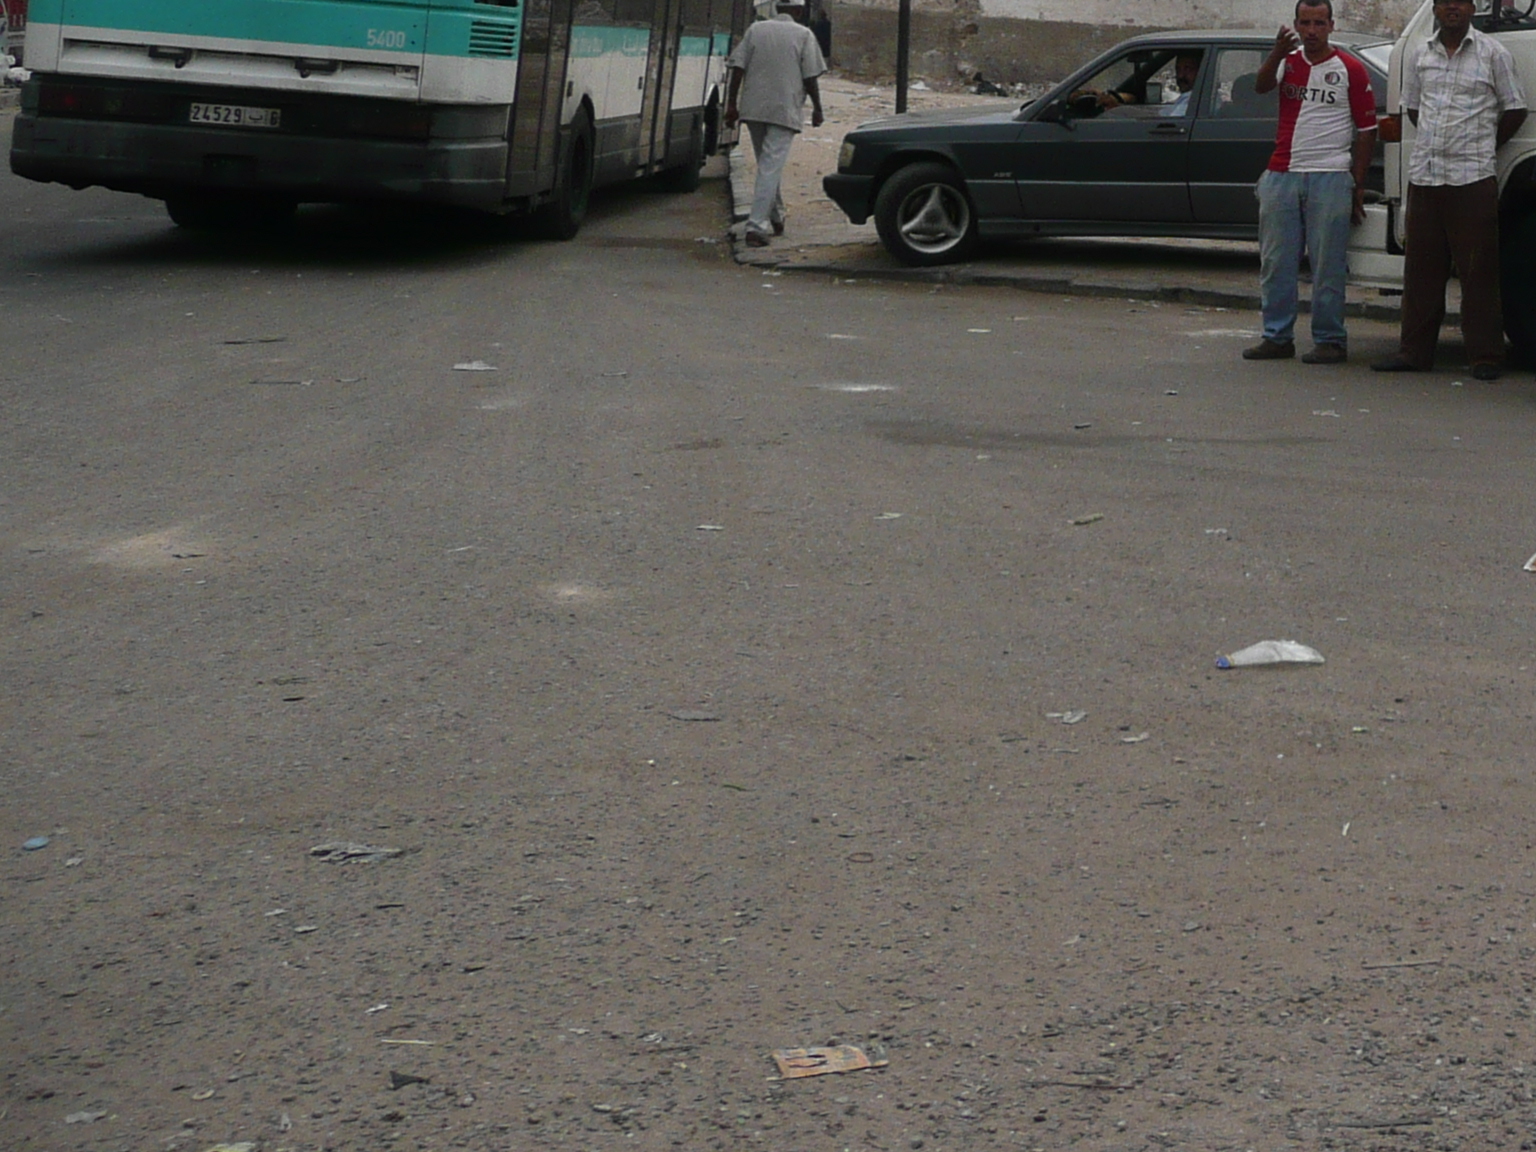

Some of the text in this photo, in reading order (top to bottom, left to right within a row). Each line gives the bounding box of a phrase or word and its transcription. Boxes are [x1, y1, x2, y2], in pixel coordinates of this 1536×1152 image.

[366, 28, 406, 49] 5400
[1282, 84, 1337, 105] ORTIS
[192, 105, 243, 124] 24529
